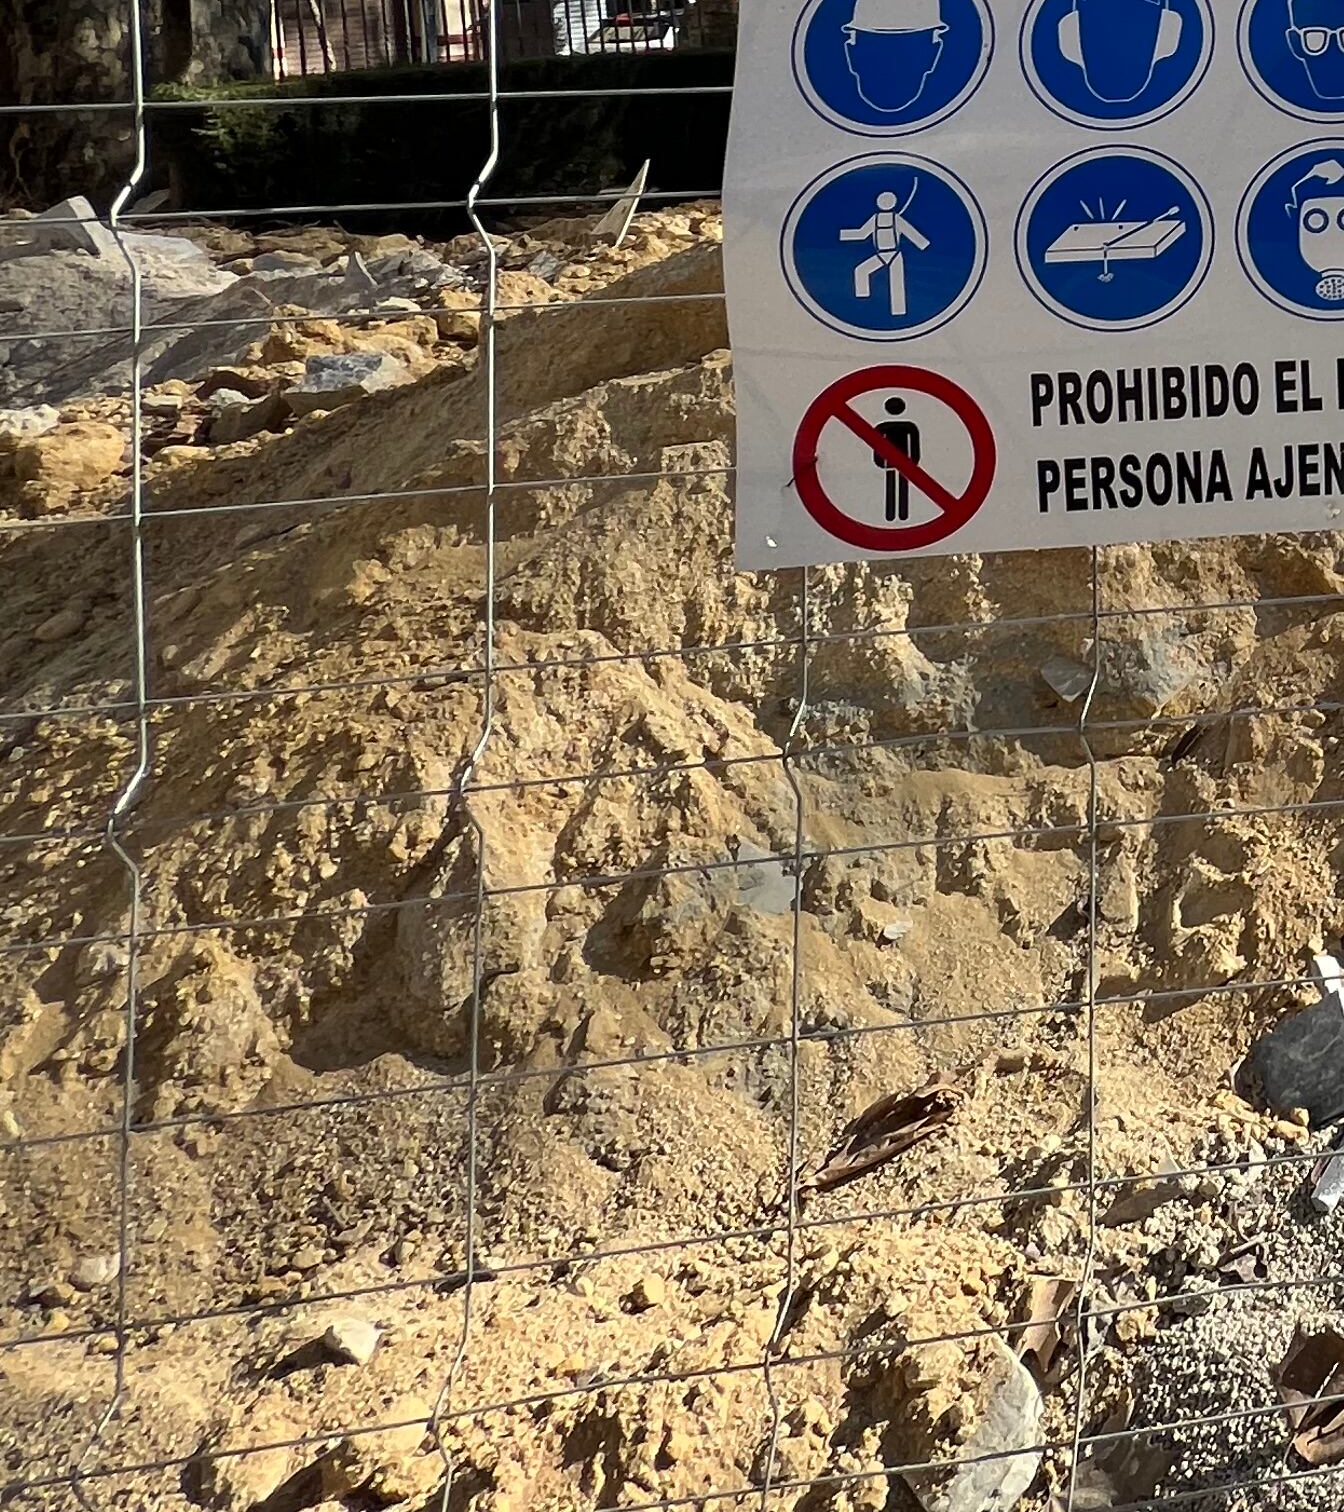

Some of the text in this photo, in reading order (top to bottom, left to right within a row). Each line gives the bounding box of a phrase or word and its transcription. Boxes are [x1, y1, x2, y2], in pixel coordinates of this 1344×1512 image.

[1031, 362, 1260, 427] PROHIBIDO
[1275, 359, 1323, 413] EL
[1037, 449, 1234, 513] PERSONA
